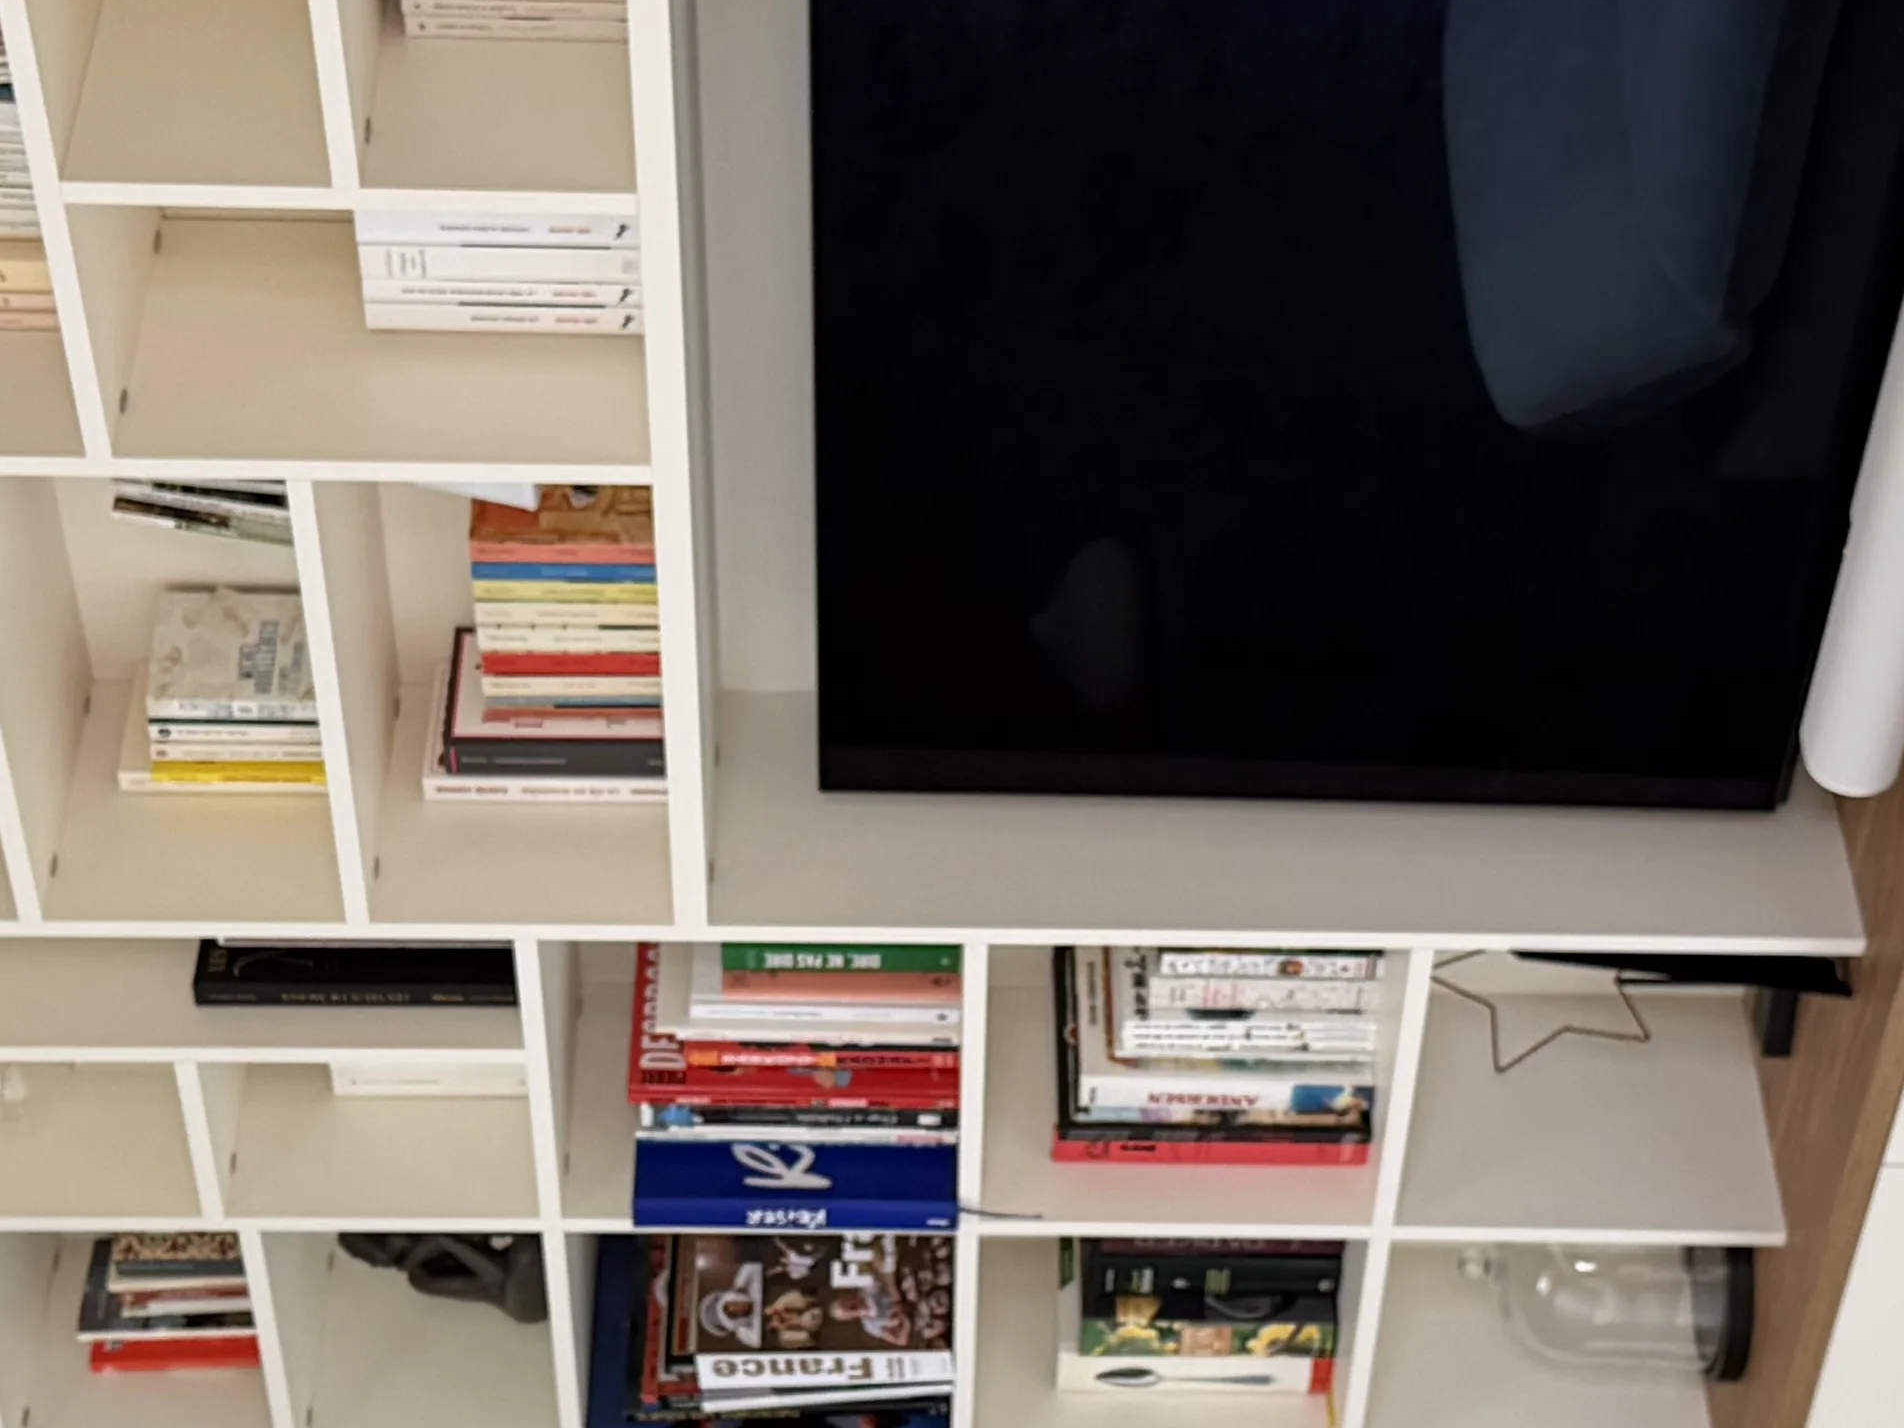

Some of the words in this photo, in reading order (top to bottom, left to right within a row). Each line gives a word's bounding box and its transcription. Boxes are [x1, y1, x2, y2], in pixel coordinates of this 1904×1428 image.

[797, 953, 823, 968] PAS
[1148, 1090, 1259, 1110] ANDERSEN
[712, 1357, 875, 1380] France
